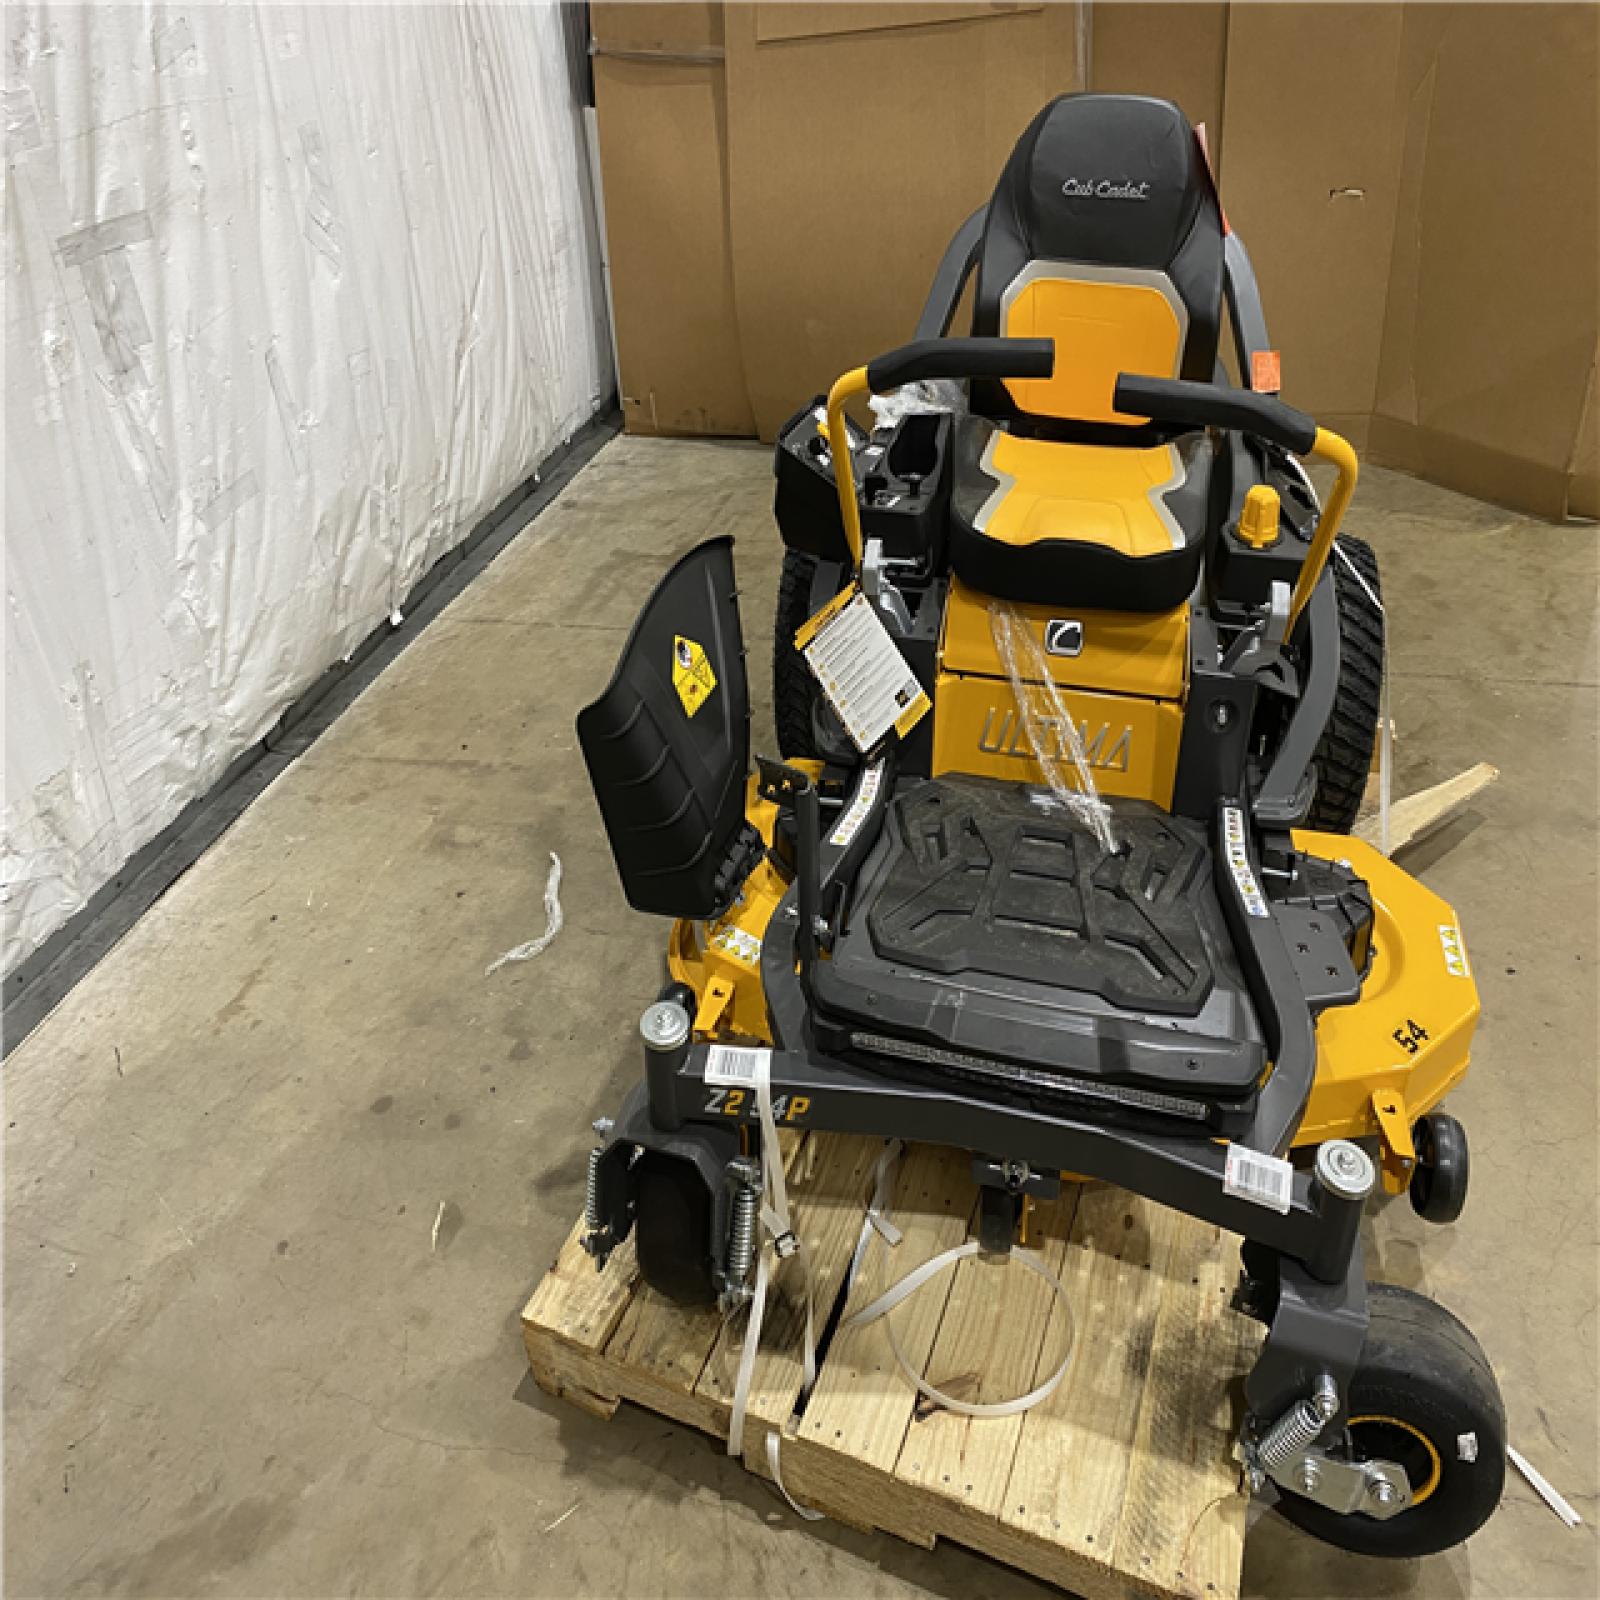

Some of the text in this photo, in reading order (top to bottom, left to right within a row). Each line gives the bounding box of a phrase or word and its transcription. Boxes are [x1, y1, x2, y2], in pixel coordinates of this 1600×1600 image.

[1062, 177, 1150, 199] Cub Cadet
[1391, 1018, 1430, 1053] 54
